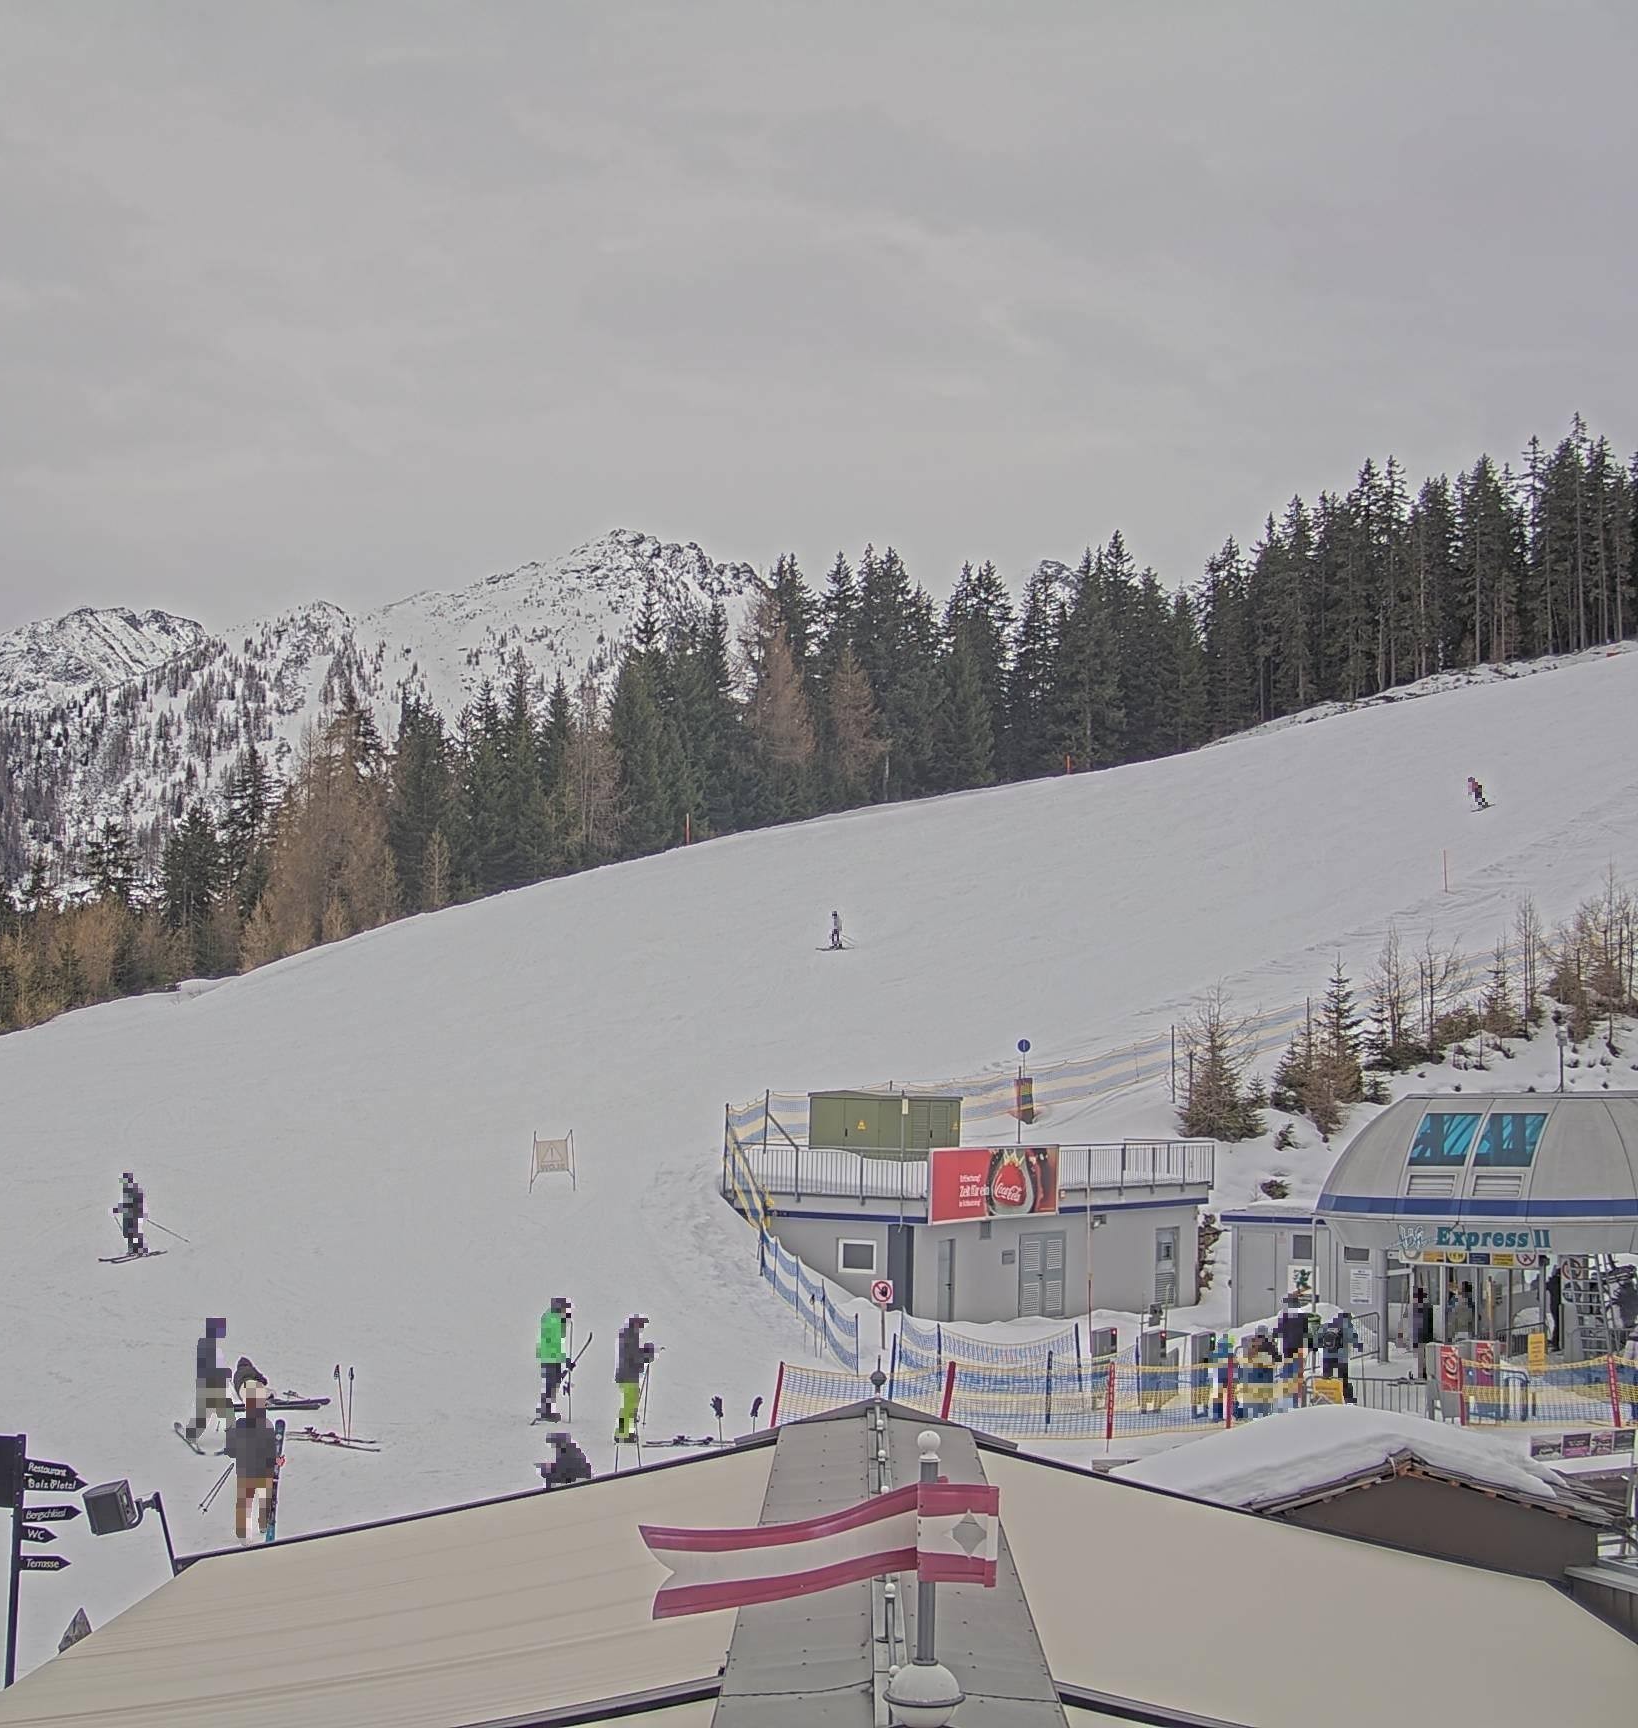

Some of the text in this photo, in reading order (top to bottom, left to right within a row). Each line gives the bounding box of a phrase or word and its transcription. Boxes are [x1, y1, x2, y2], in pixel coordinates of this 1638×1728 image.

[1436, 1226, 1529, 1251] Express
[1533, 1229, 1551, 1249] II
[27, 1528, 46, 1541] WC
[26, 1558, 61, 1569] Terrasse
